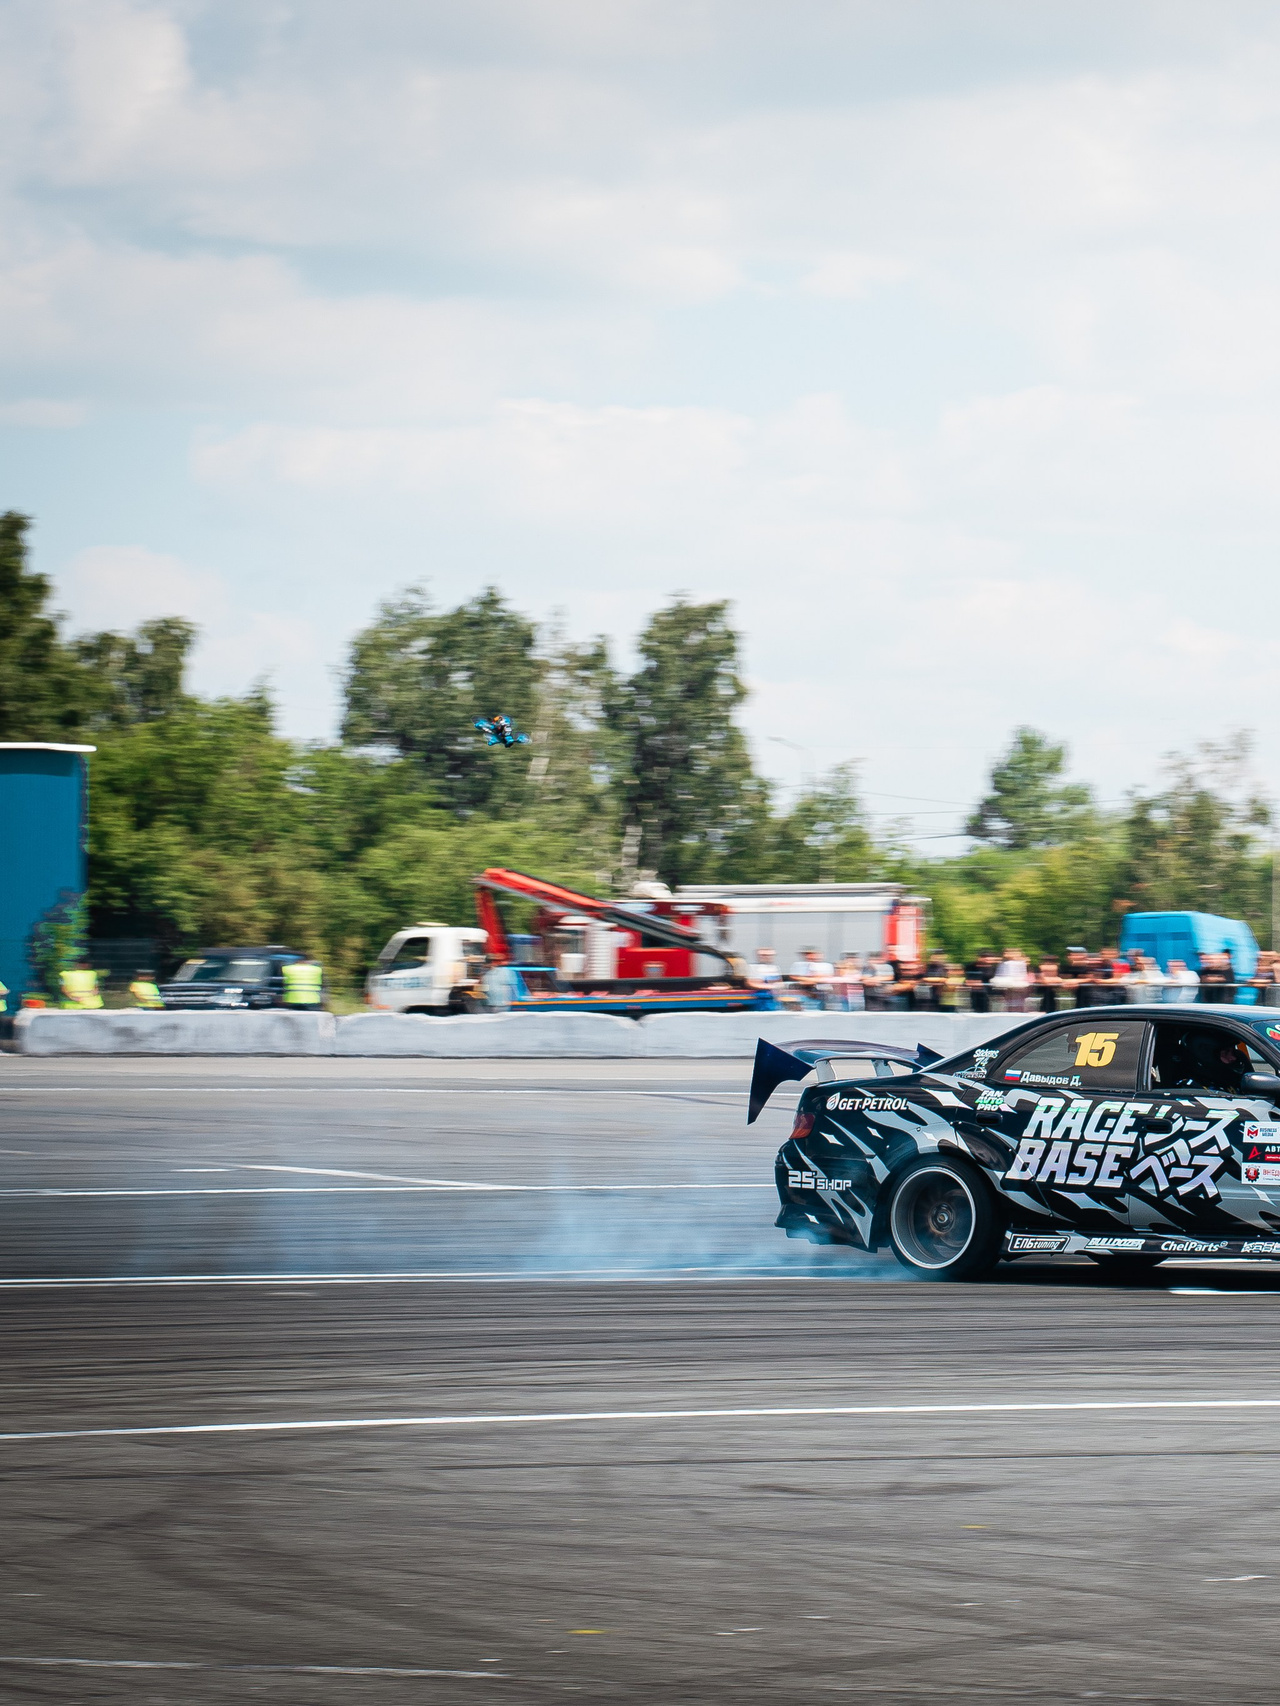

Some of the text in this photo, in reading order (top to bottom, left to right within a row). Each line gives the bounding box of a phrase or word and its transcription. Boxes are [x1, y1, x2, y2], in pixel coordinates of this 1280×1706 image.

[1074, 1032, 1120, 1068] 15
[1020, 1071, 1082, 1087] Давыдов Д.
[977, 1103, 999, 1111] PRO
[1022, 1097, 1153, 1144] RACE
[1005, 1138, 1134, 1188] BASE
[1087, 1237, 1146, 1248] BULLDOZER
[1160, 1240, 1220, 1252] ChelParts
